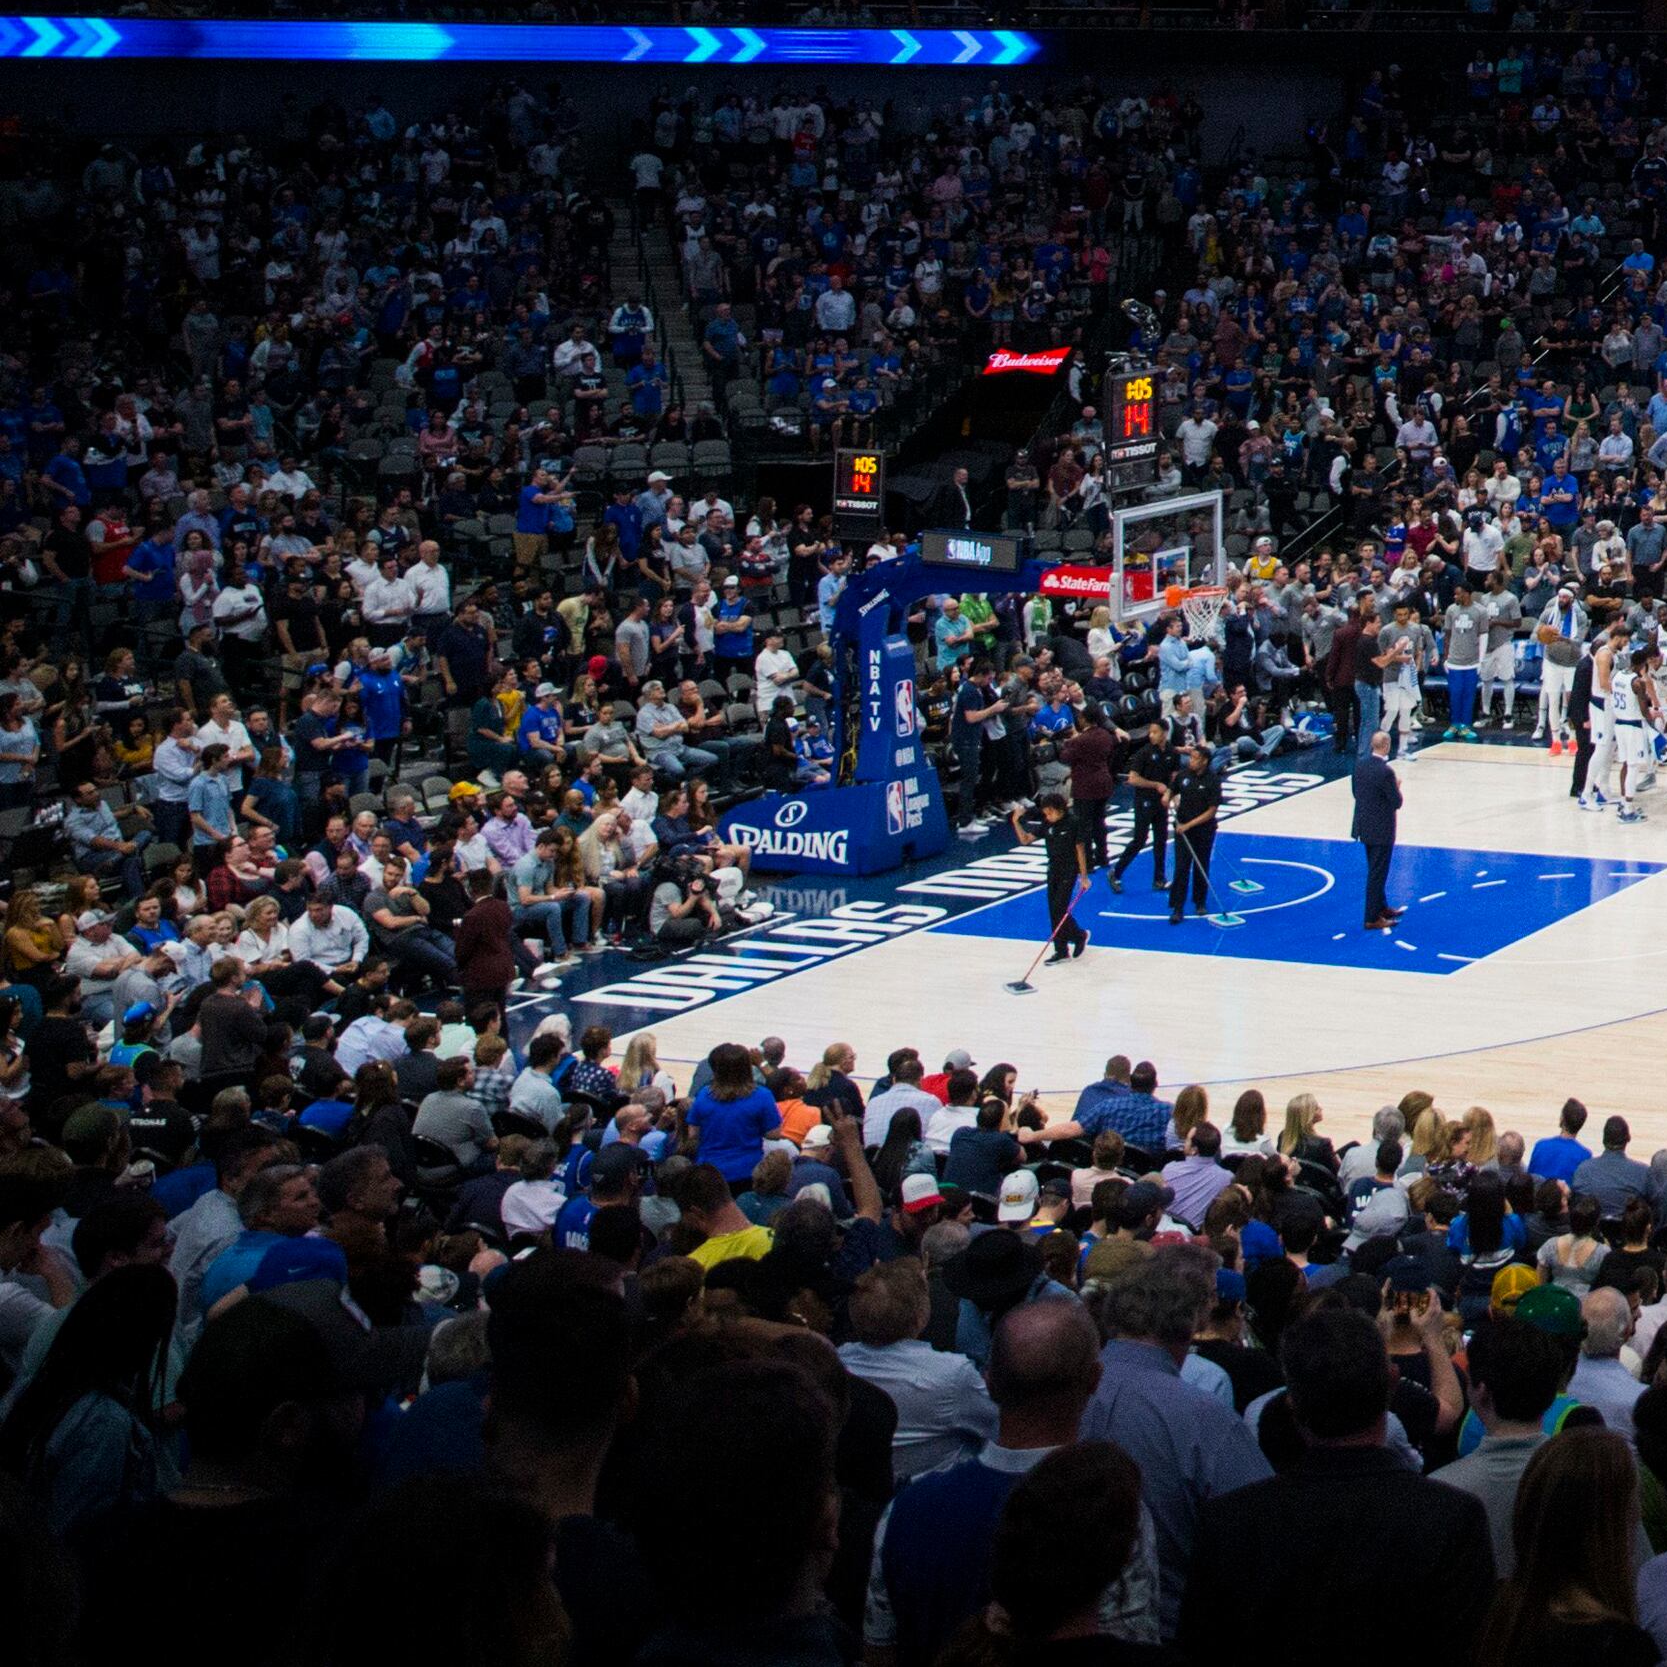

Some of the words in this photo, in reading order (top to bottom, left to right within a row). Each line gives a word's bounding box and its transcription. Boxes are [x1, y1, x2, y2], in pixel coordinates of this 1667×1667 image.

[990, 353, 1063, 368] Budweiser
[1124, 403, 1149, 437] 14
[1124, 442, 1157, 456] TISSOT
[849, 500, 879, 510] TISSOT
[858, 588, 890, 617] SPALDING
[869, 649, 881, 696] NBA
[1613, 692, 1626, 710] 55
[869, 701, 881, 732] TV
[728, 823, 849, 866] SPALDING
[569, 900, 948, 1010] DALLAS
